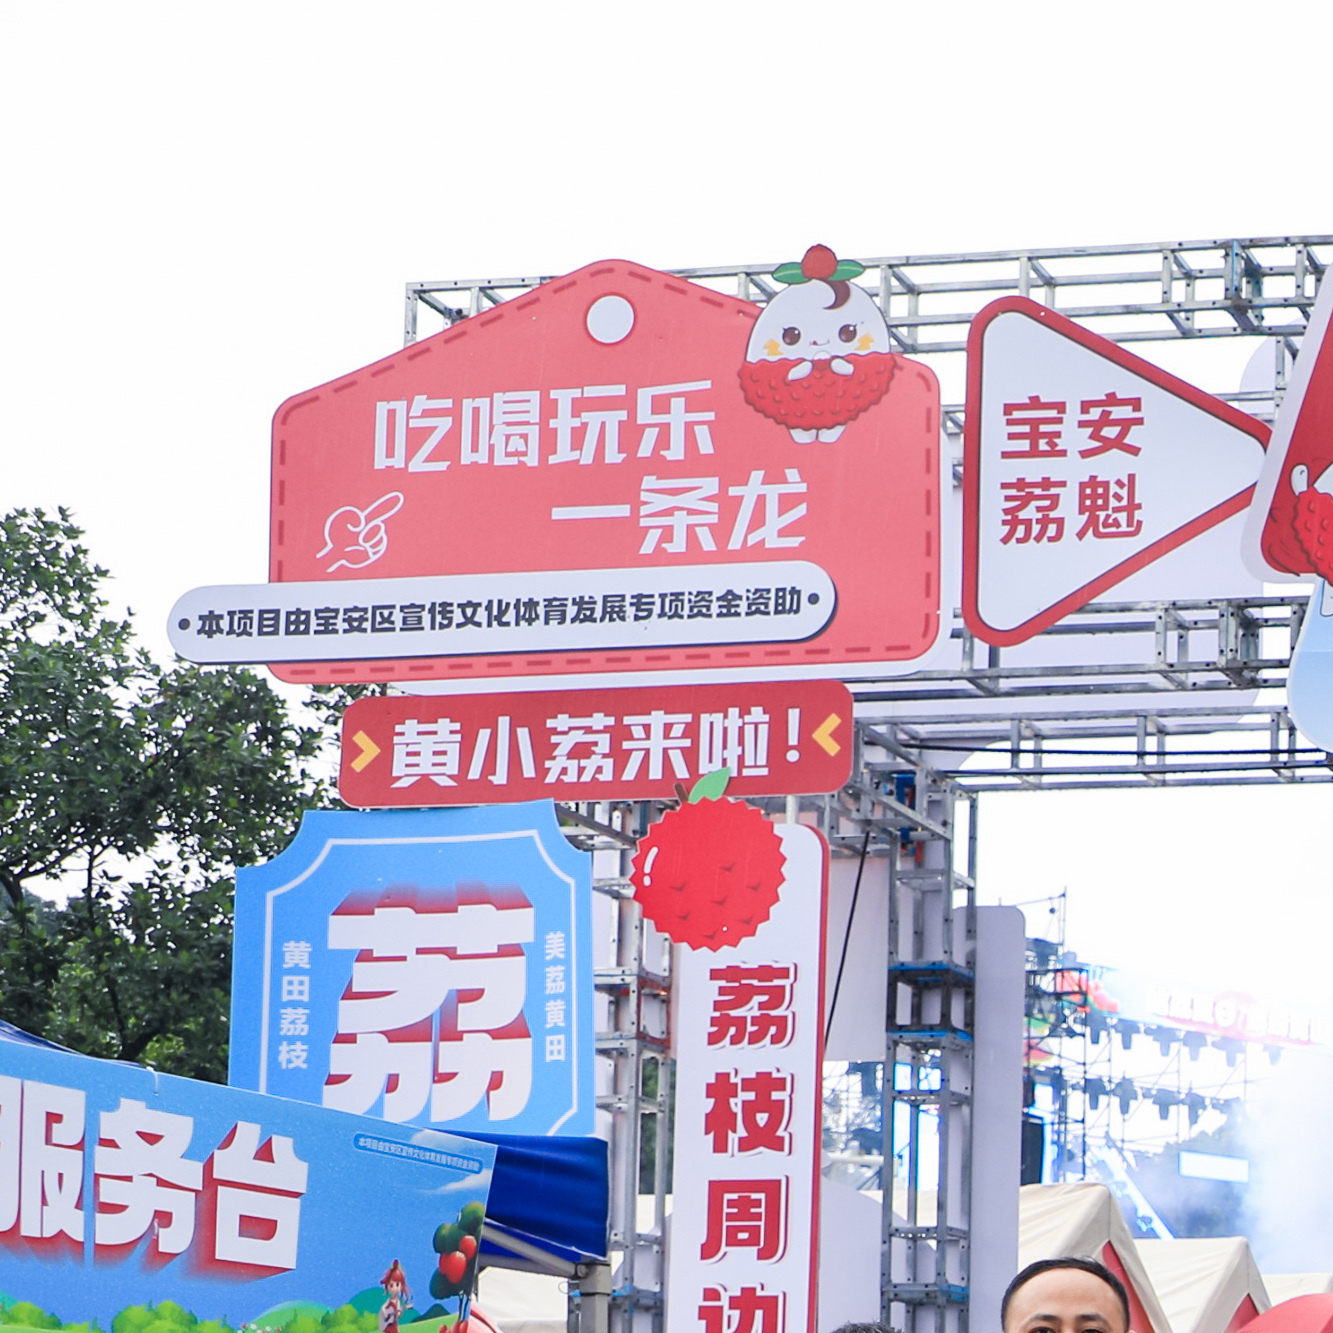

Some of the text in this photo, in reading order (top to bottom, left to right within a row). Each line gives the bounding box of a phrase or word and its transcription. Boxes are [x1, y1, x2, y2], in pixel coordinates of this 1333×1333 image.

[373, 379, 717, 473] 吃喝玩乐
[1000, 391, 1145, 462] 宝安
[551, 469, 808, 555] 一条龙
[1000, 474, 1145, 546] 荔魁
[196, 586, 802, 640] 本项目由宝安区宣传文化体育发展专项资金资助
[278, 940, 313, 1071] 黄田荔枝
[324, 902, 535, 1124] 荔
[544, 931, 567, 1064] 美荔黄田
[0, 1075, 309, 1269] 服务台
